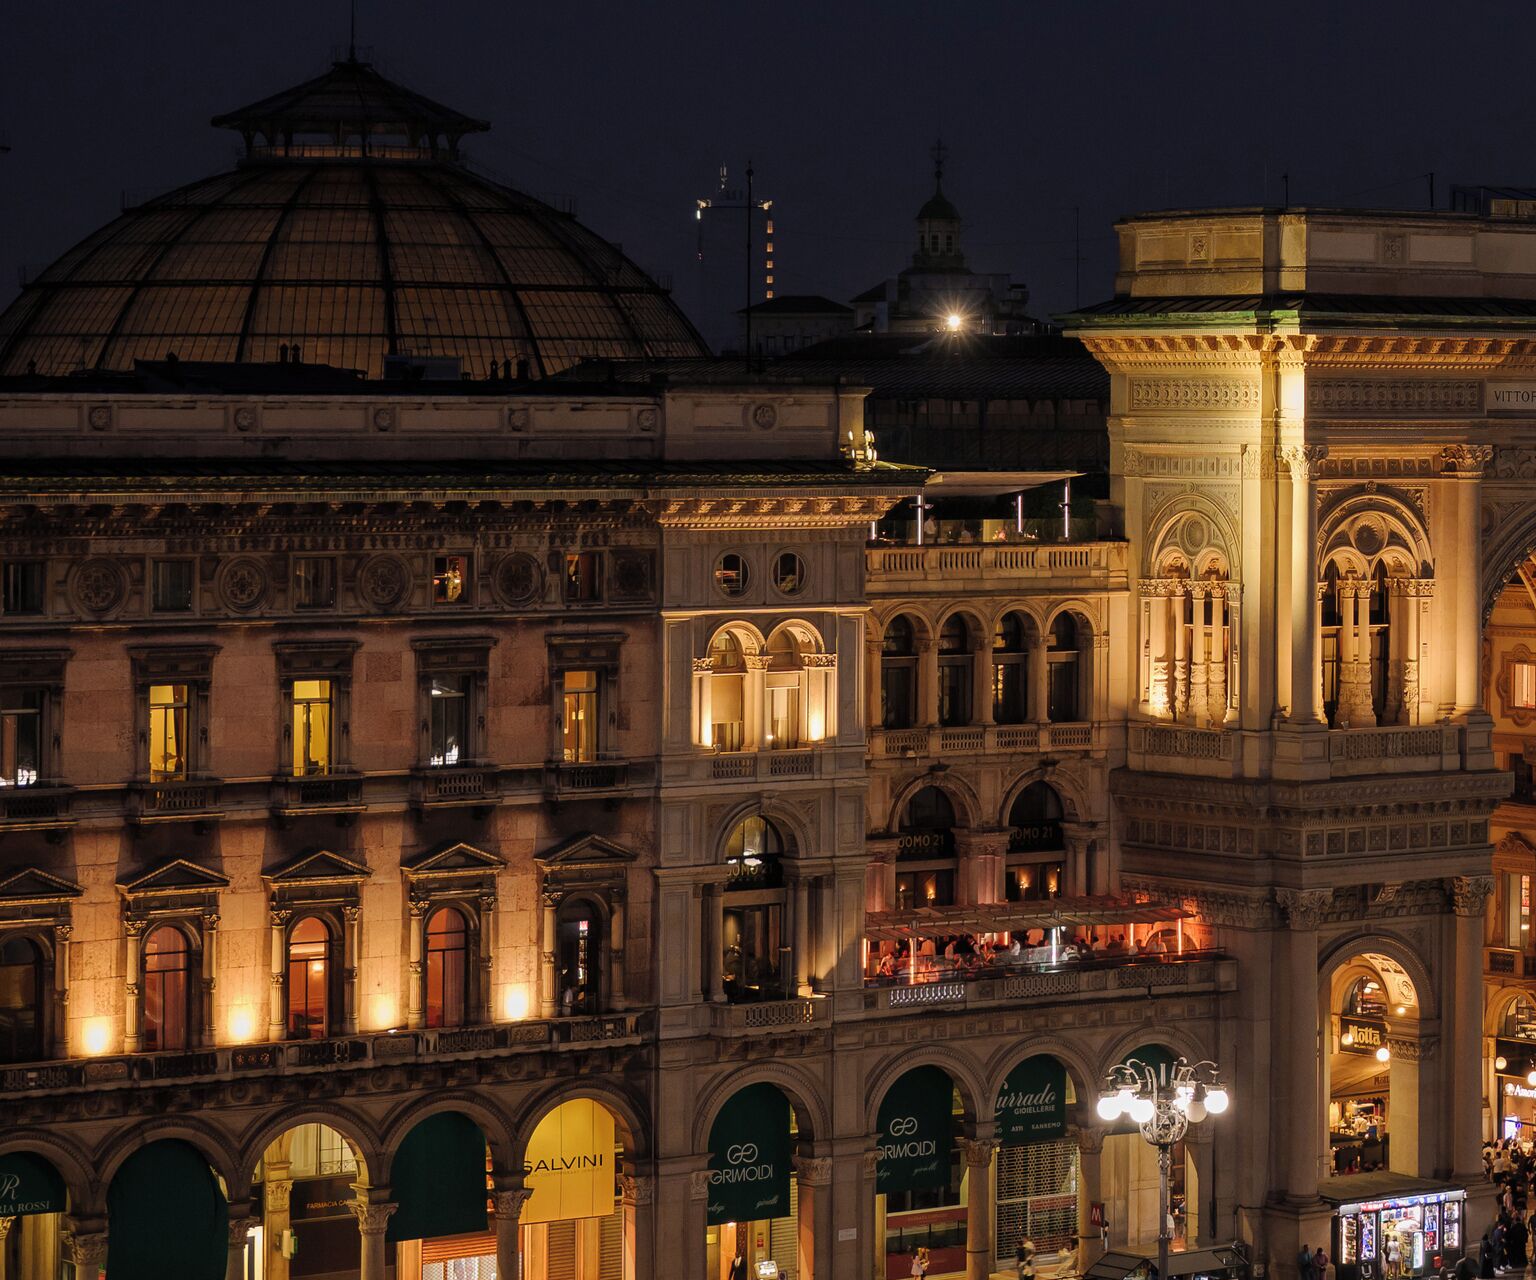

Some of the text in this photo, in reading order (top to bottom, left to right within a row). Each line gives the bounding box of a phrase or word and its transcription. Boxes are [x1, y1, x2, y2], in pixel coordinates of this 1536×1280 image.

[1008, 827, 1040, 841] UOMO
[897, 835, 930, 848] UOMO
[1348, 1024, 1381, 1045] Motta
[1014, 1105, 1056, 1115] GIOIELLERIE
[523, 1153, 603, 1175] SALVINI
[711, 1164, 773, 1185] GRIMOLDI
[17, 1200, 50, 1212] ROSSI
[306, 1201, 337, 1209] FARMACIA
